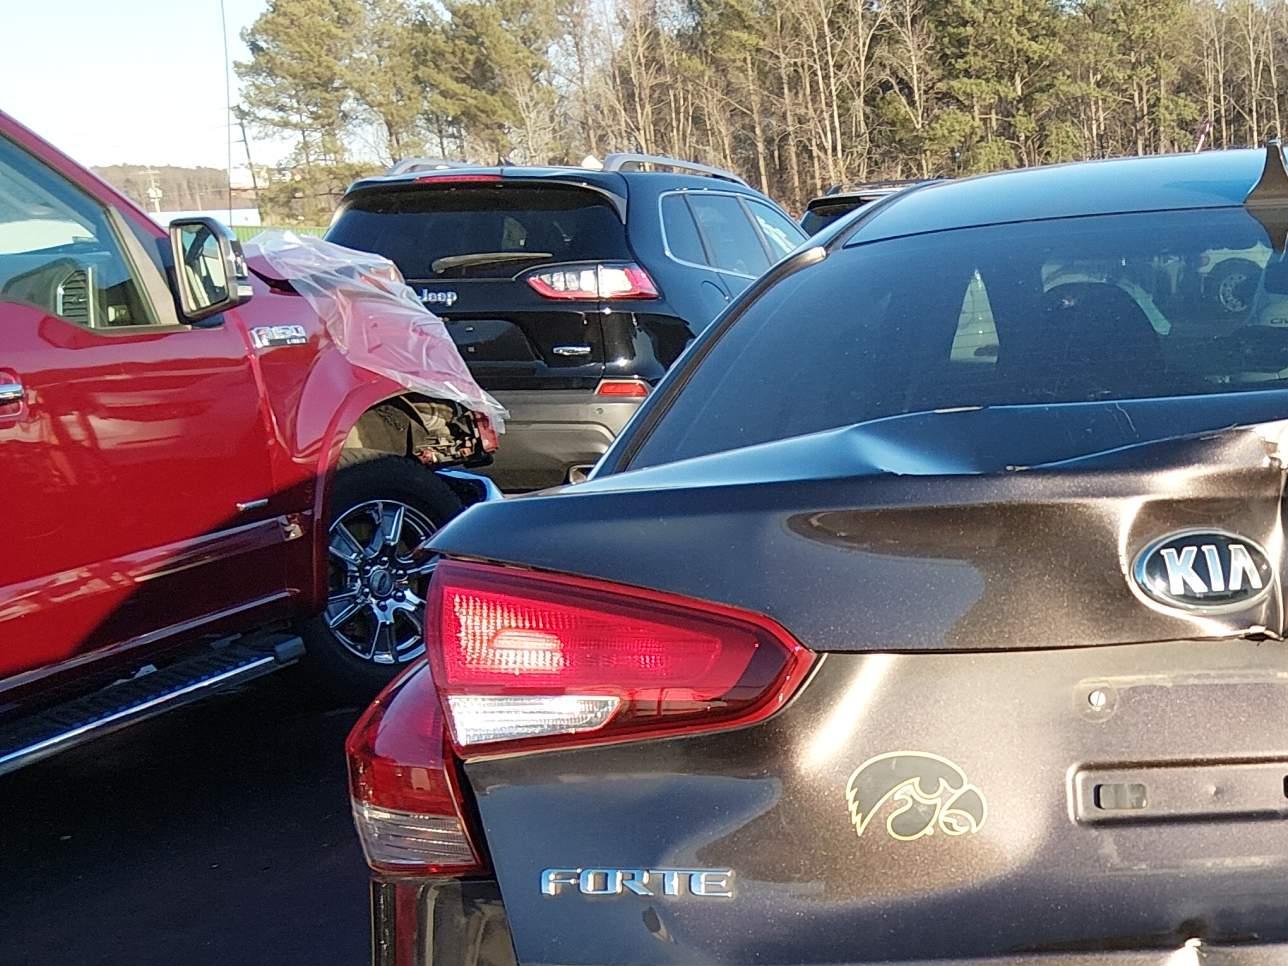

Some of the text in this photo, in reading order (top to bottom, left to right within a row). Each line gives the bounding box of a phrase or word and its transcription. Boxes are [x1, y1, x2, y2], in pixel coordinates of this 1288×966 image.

[417, 288, 457, 307] Jeep
[1160, 544, 1263, 596] KIA
[541, 868, 734, 898] FORTE
